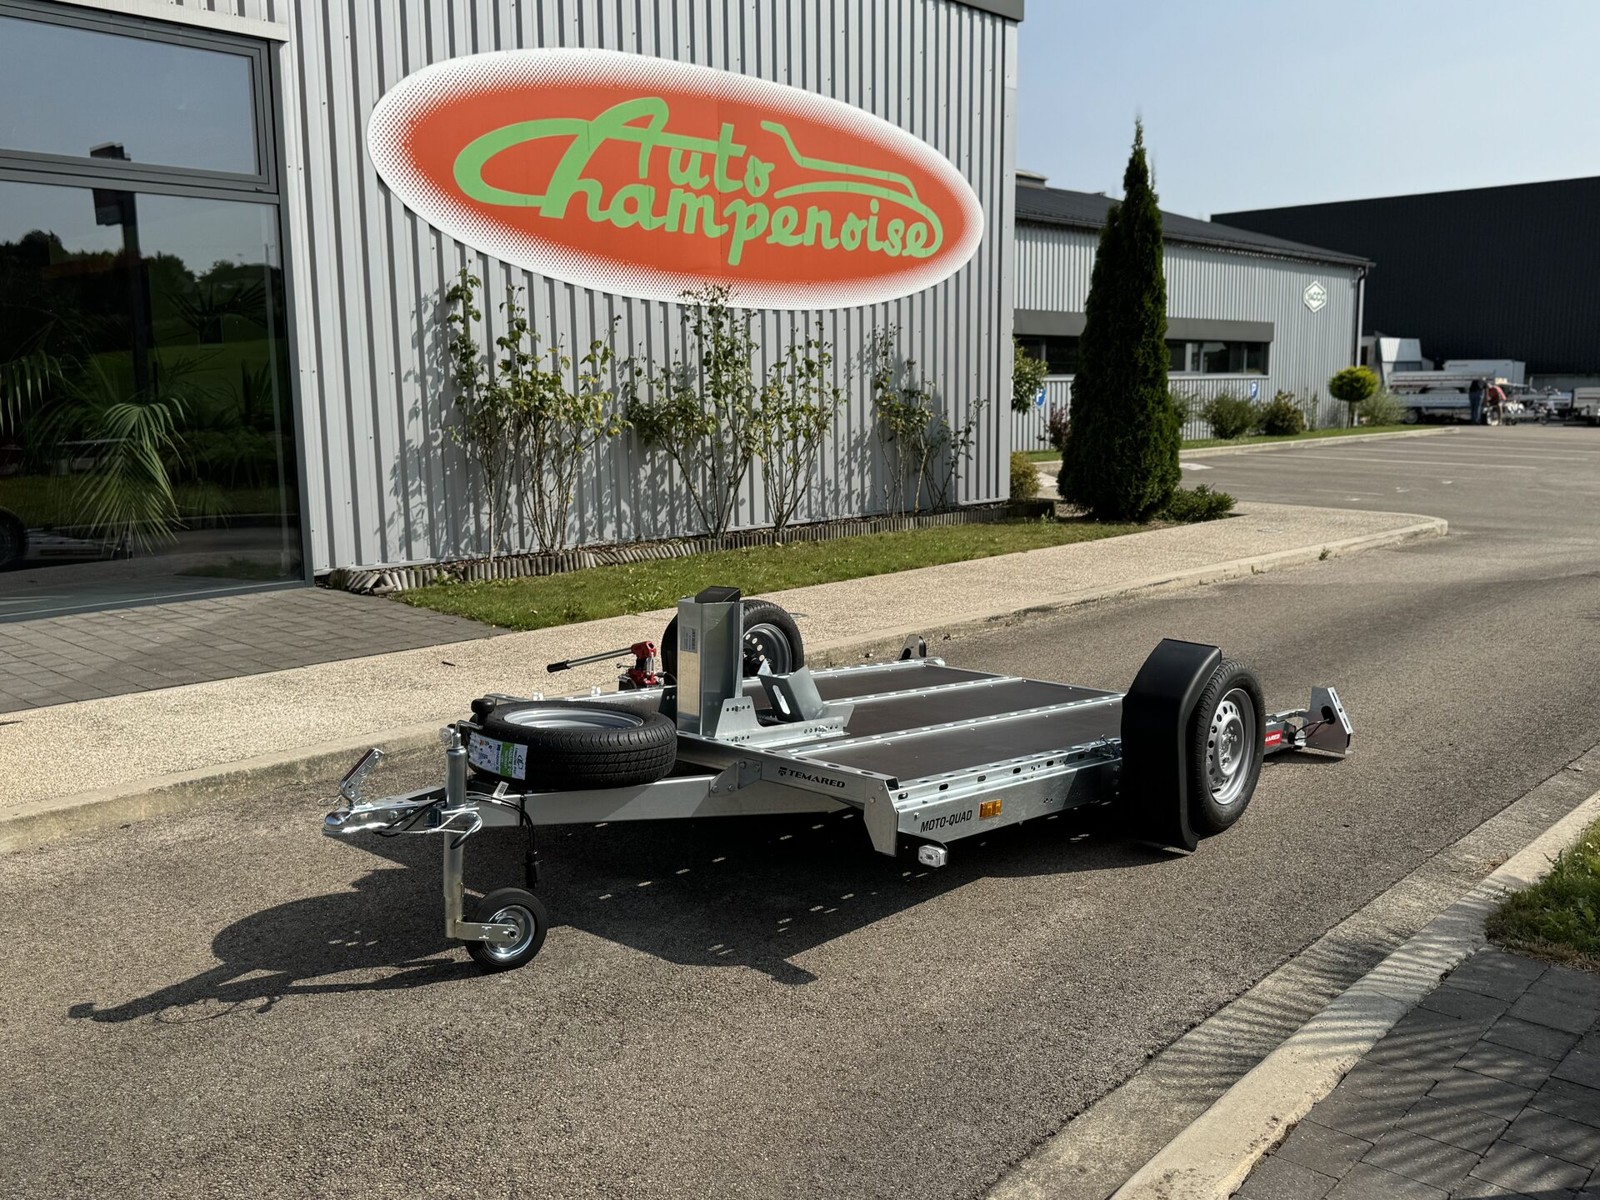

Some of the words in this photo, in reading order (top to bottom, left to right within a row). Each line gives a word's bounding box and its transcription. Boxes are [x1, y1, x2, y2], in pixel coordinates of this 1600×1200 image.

[582, 97, 775, 197] Auto
[453, 118, 943, 266] Champenoise
[788, 769, 846, 788] TEMARED
[920, 810, 973, 833] MOTO-QUAD
